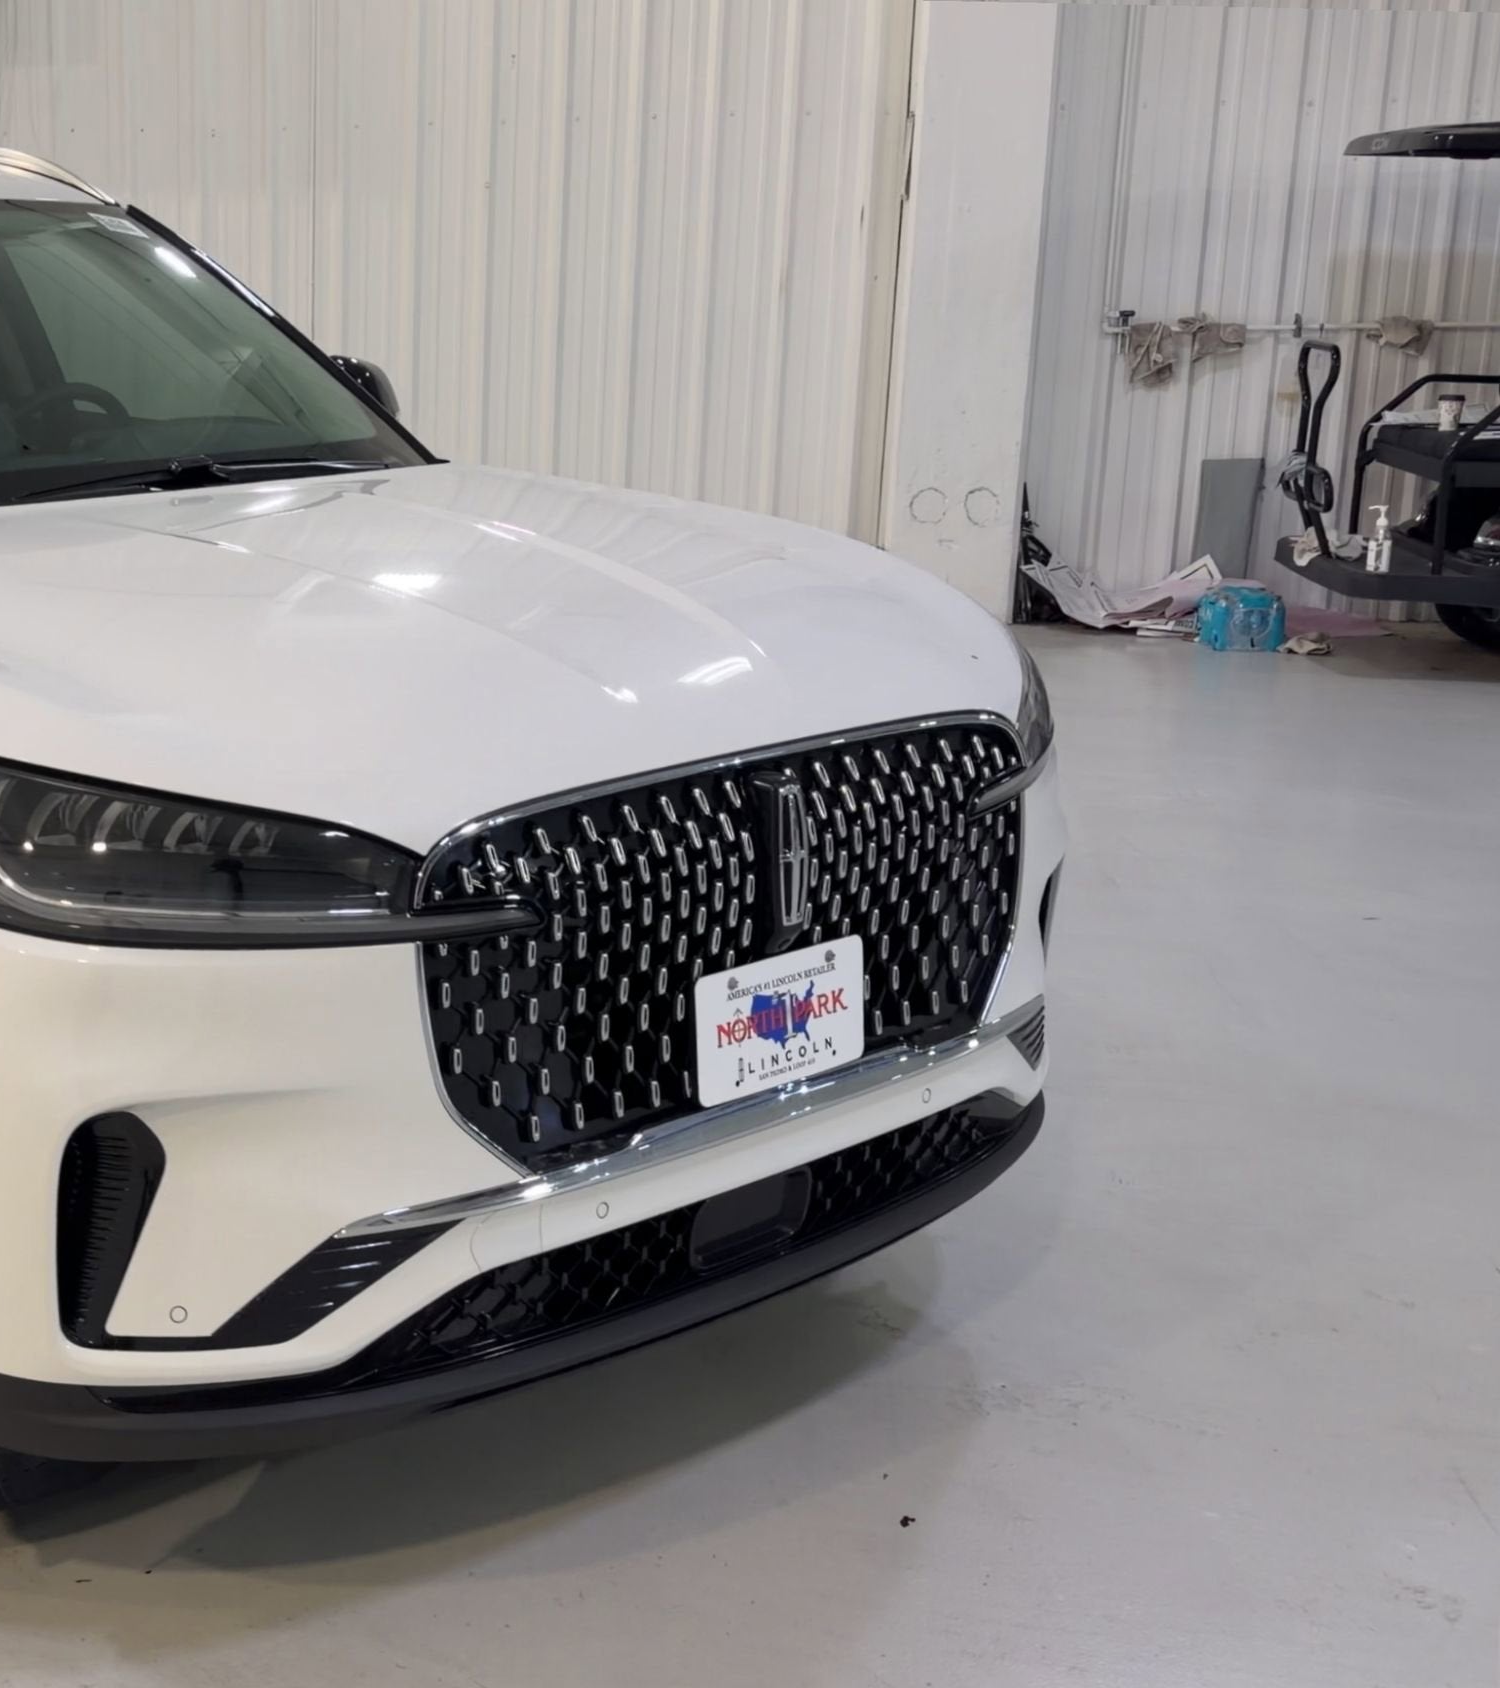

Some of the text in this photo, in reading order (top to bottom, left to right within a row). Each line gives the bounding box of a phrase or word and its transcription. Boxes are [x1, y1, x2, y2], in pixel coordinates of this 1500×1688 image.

[772, 971, 803, 988] LINCOLN
[803, 962, 837, 979] RETAILER
[716, 987, 848, 1048] NORTH PARK
[748, 1036, 833, 1074] LINCOLN
